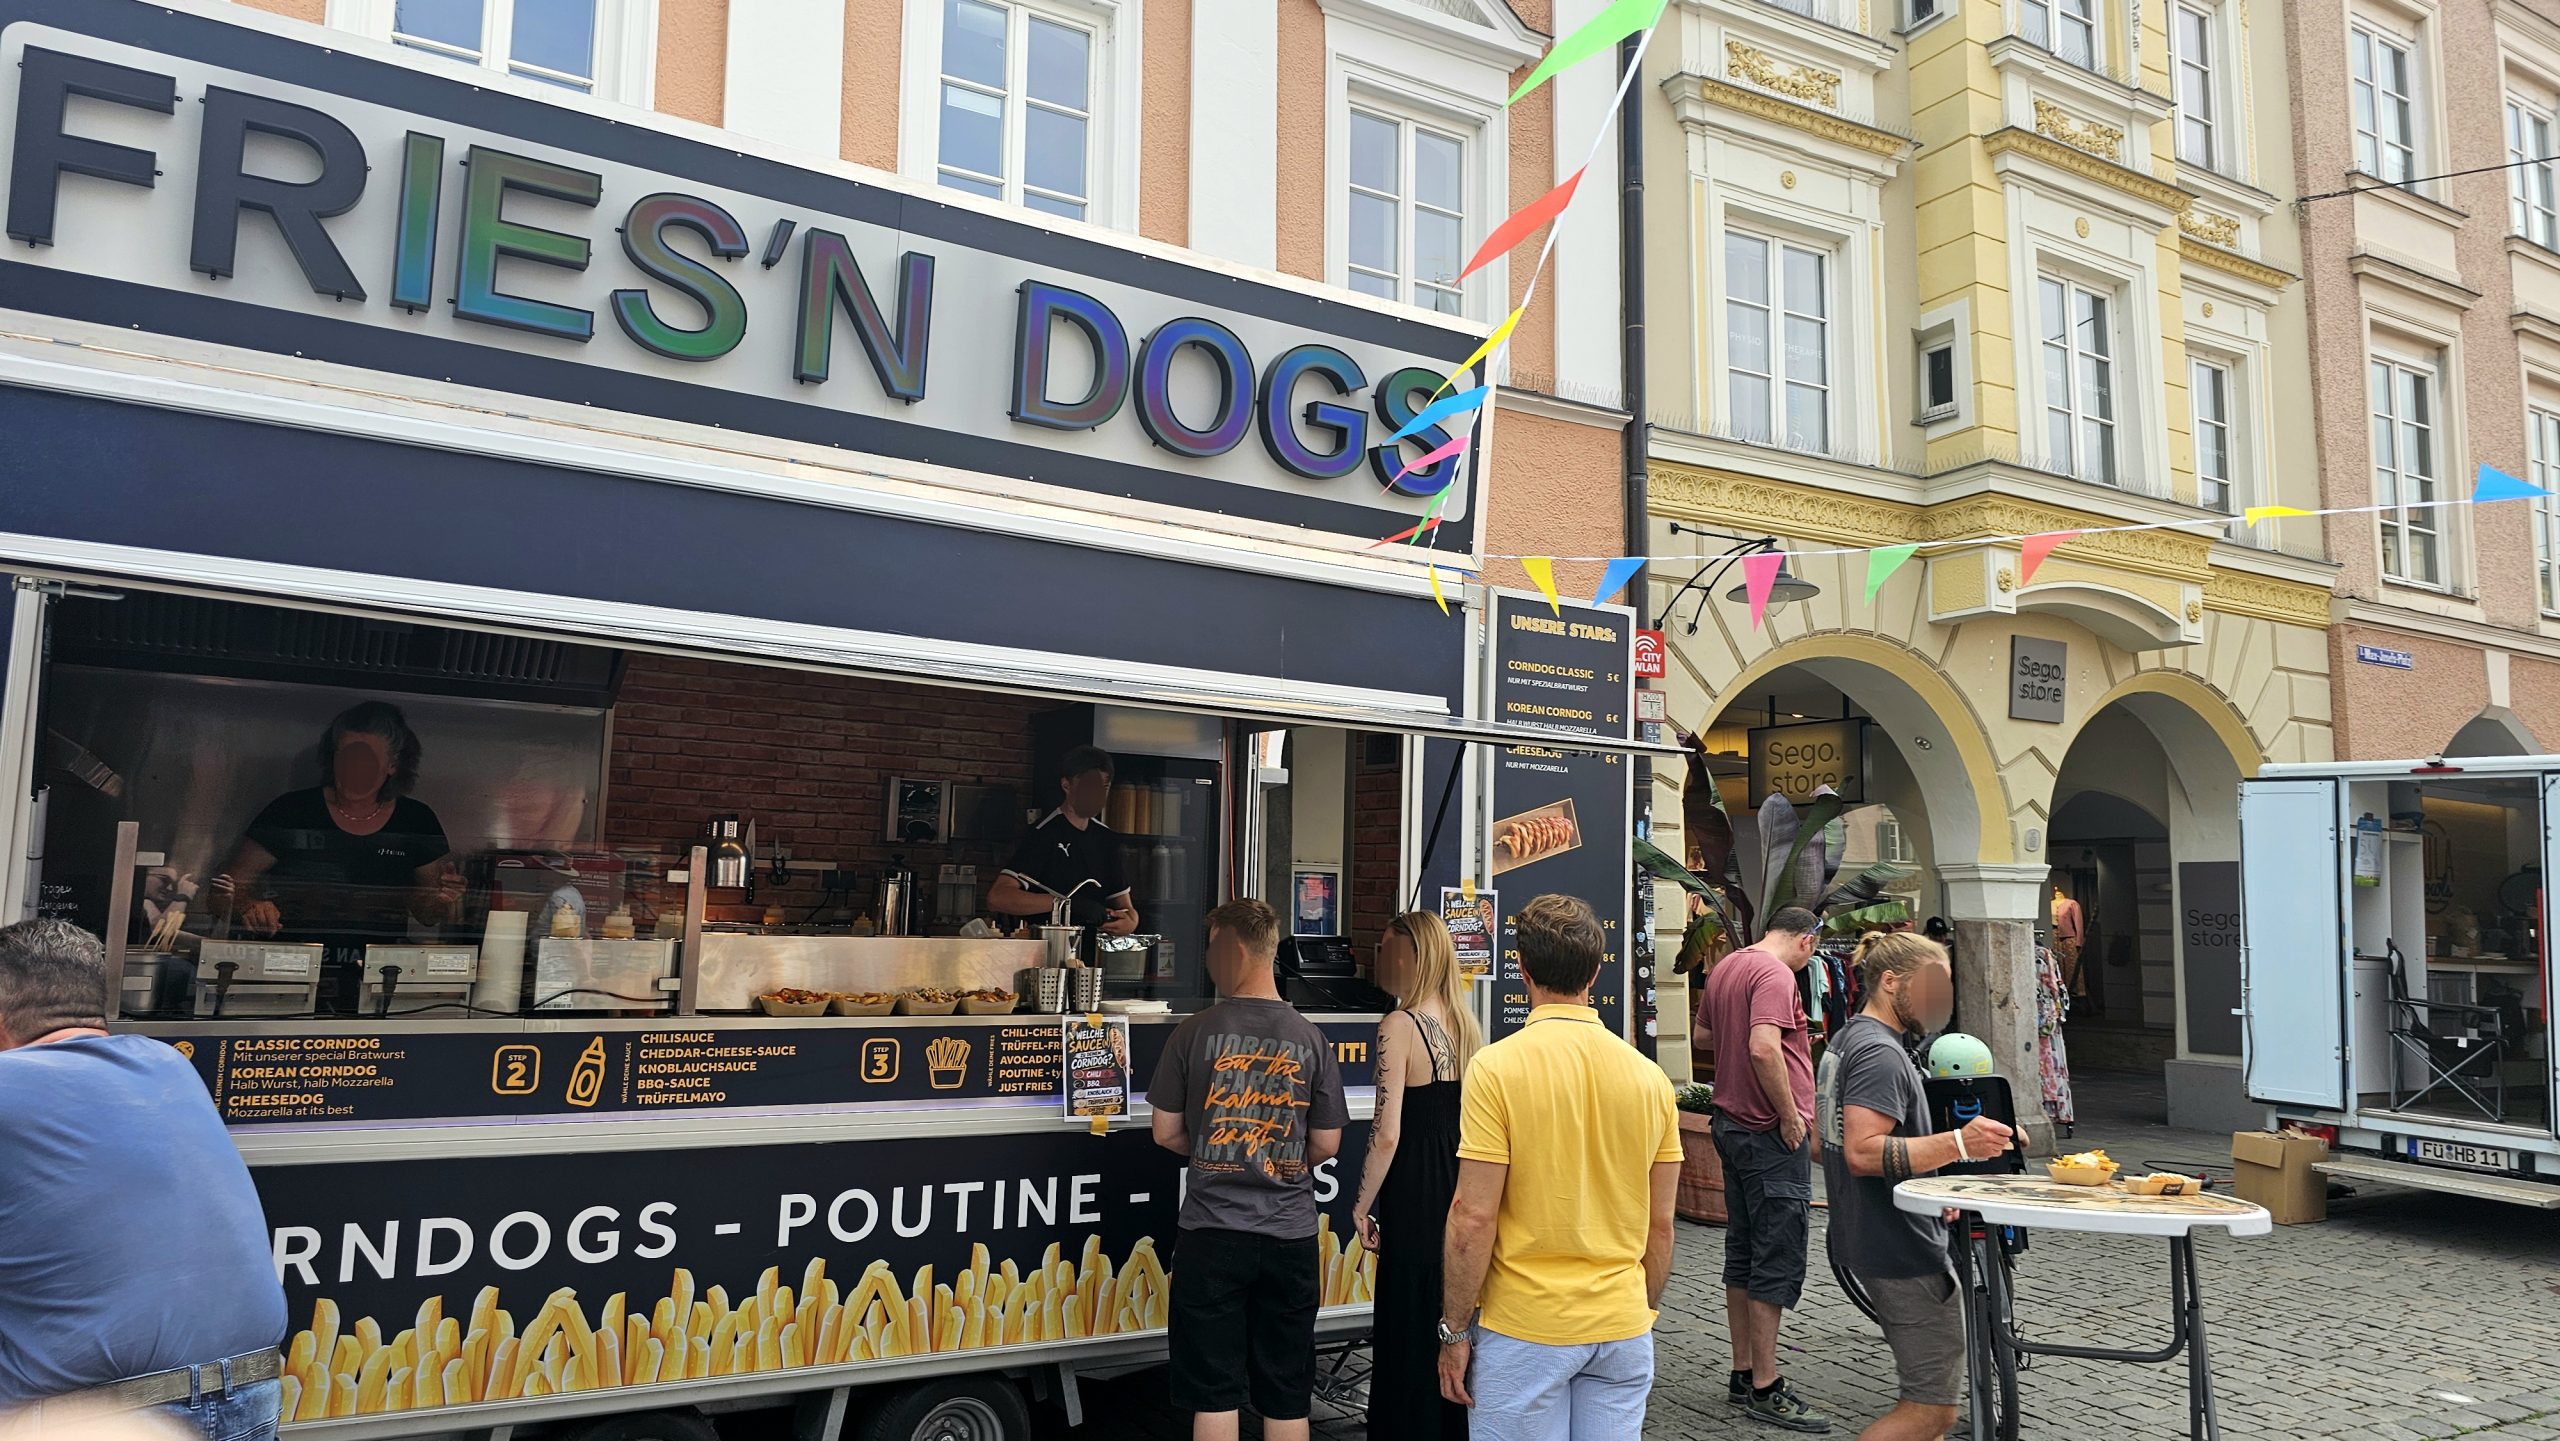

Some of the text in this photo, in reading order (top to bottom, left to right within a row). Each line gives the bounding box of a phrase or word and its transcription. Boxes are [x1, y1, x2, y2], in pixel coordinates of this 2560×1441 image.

[5, 44, 1464, 498] FRIES'N DOGS
[1510, 615, 1617, 643] UNSERE STARS:
[1642, 652, 1661, 663] CITY
[1508, 660, 1594, 679] CORNDOG CLASSIC
[1635, 662, 1660, 673] WLAN
[2018, 655, 2065, 683] Sego.
[1521, 678, 1532, 686] MIT
[1532, 680, 1588, 693] SPEZIALBRATWURST
[2019, 681, 2062, 703] store
[1507, 702, 1593, 720] KOREAN CORNDOG
[1560, 724, 1598, 735] MOZZARELLA
[1768, 742, 1840, 769] Sego.
[1530, 763, 1569, 774] MOZZARELLA
[1772, 771, 1837, 795] store
[2187, 909, 2240, 931] Sego
[640, 1032, 715, 1044] CHILISAUCE
[1076, 1029, 1104, 1040] WELCHE
[234, 1038, 380, 1051] CLASSIC CORNDOG
[624, 1041, 632, 1062] SAUCE
[1204, 1033, 1314, 1065] NOBODY
[233, 1050, 405, 1063] Mit unserer special Bratwurst
[508, 1054, 527, 1062] STEP
[639, 1046, 797, 1059] CHEDDAR-CHEESE-SAUCE
[1338, 1042, 1367, 1063] IT!
[871, 1053, 889, 1077] 3
[1000, 1055, 1051, 1065] AVOCADO
[1071, 1054, 1113, 1070] CORNDOG?
[232, 1065, 377, 1079] KOREAN CORNDOG
[506, 1062, 526, 1087] 2
[638, 1061, 757, 1074] KNOBLAUCHSAUCE
[999, 1069, 1043, 1078] POUTINE
[230, 1077, 394, 1090] Halb Wurst, halb Mozzarella
[637, 1077, 711, 1090] BBQ-SAUCE
[999, 1082, 1053, 1092] JUST FRIES
[1213, 1070, 1297, 1098] CARES
[228, 1093, 324, 1107] CHEESEDOG
[636, 1091, 726, 1105] TRÜFFELMAYO
[228, 1105, 354, 1118] Mozzarella at its best
[1209, 1104, 1298, 1128] ABOUT
[2423, 1142, 2502, 1167] FÜ HB 11
[272, 1201, 678, 1287] RNDOGS
[778, 1174, 1101, 1248] POUTINE
